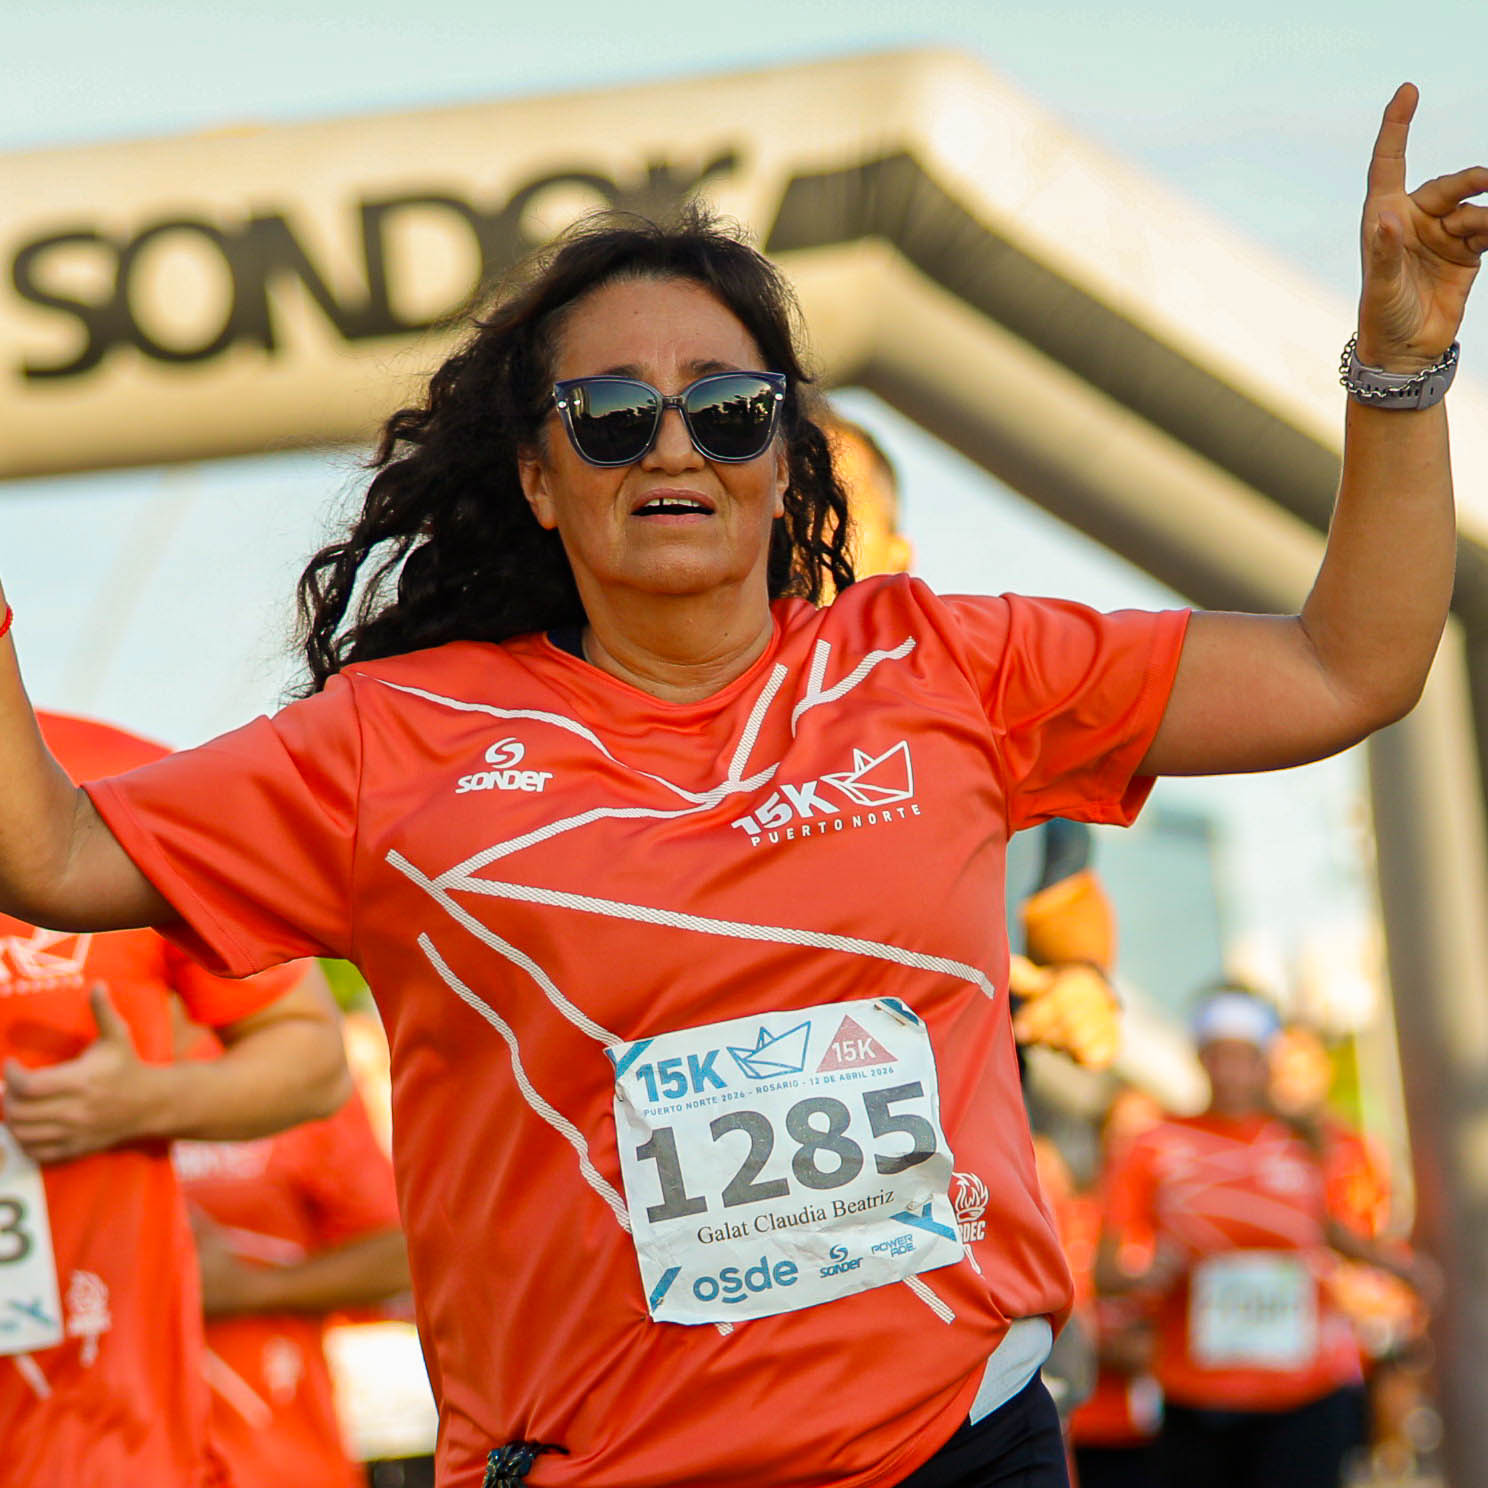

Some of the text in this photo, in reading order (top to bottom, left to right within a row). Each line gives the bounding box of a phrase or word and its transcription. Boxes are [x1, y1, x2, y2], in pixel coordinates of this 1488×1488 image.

[731, 780, 840, 835] 15K
[636, 1050, 728, 1103] 15K
[831, 1037, 876, 1063] 15K
[643, 1103, 683, 1117] PUERTO
[685, 1097, 718, 1111] NORTE
[722, 1090, 746, 1103] 2026
[755, 1079, 799, 1095] ROSARIO
[809, 1077, 820, 1087] 12
[823, 1075, 836, 1085] DE
[839, 1070, 867, 1083] ABRIL
[870, 1066, 894, 1078] 2026
[636, 1081, 937, 1224] 1285
[697, 1188, 896, 1244] Galat Claudia Beatriz
[693, 1255, 799, 1304] osde
